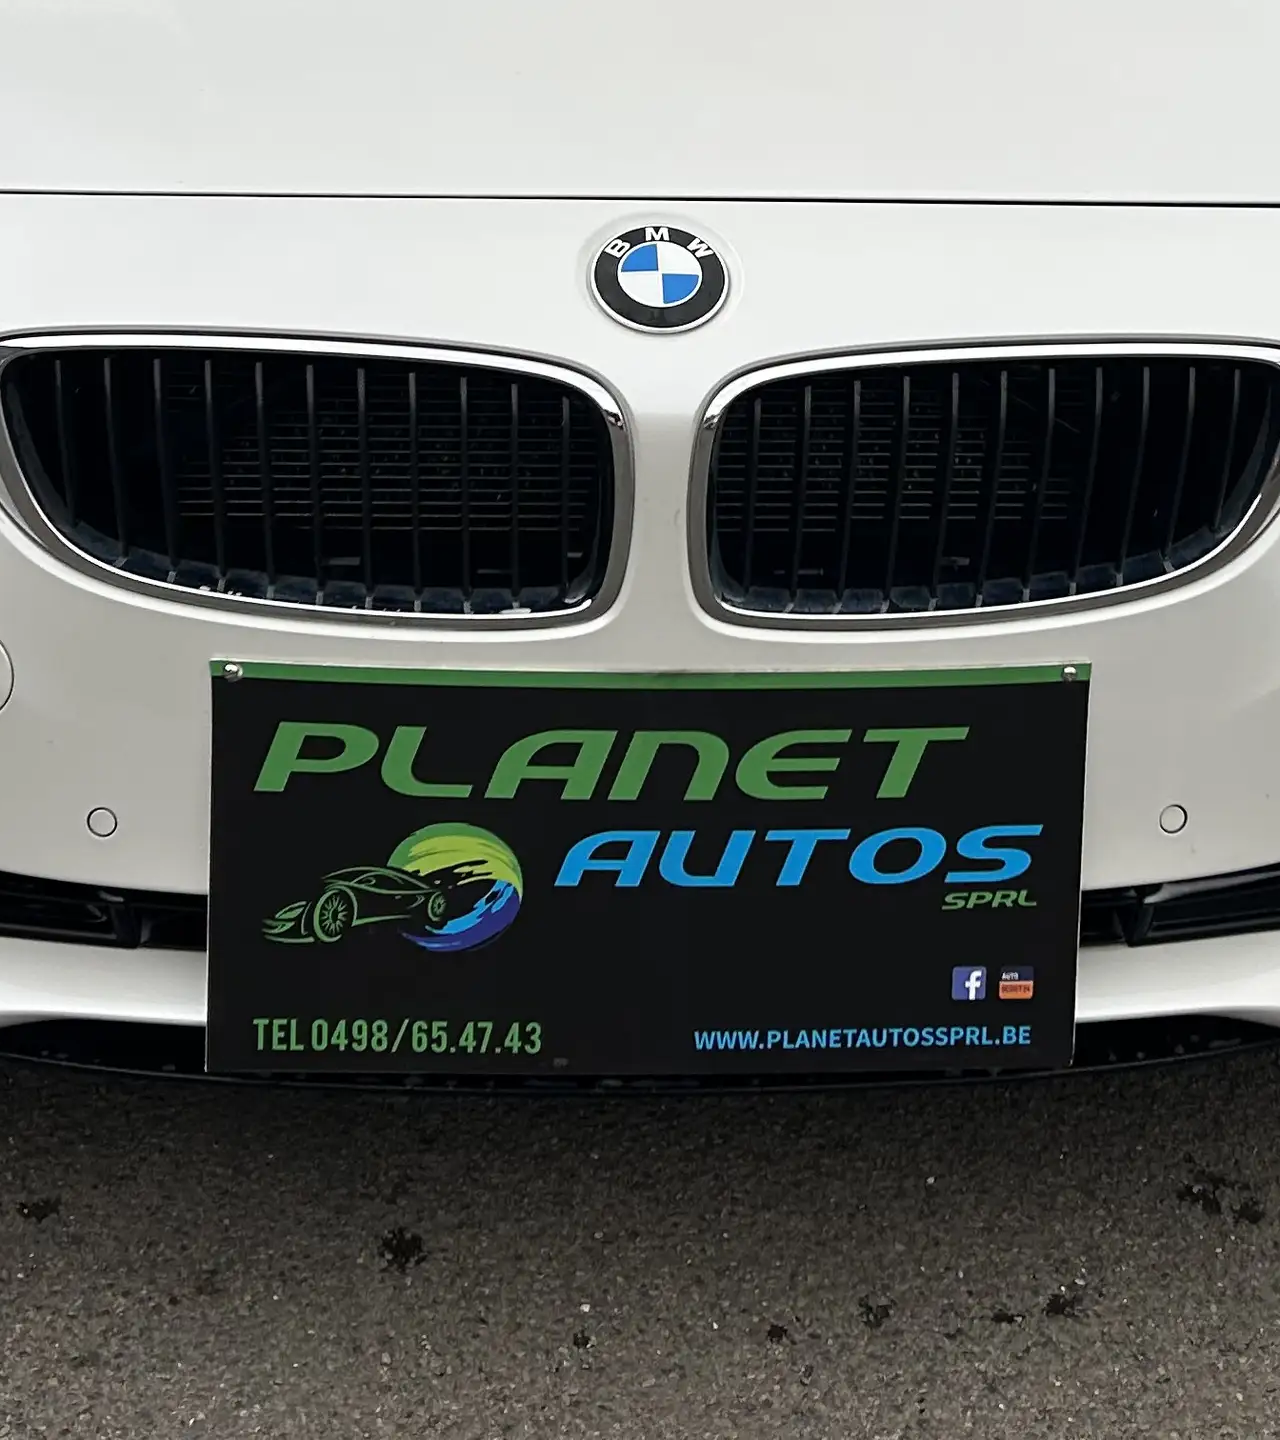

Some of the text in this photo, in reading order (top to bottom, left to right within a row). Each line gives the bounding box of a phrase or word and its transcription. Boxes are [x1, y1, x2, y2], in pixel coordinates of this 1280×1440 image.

[604, 227, 714, 258] BMW
[253, 721, 970, 801] PLANET
[554, 823, 1044, 888] AUTOS
[941, 889, 1038, 910] SPRL
[252, 1018, 542, 1055] TEL 0498/65.47.43
[693, 1025, 1032, 1050] WWW.PLANETAUTOSSPRL.BE
